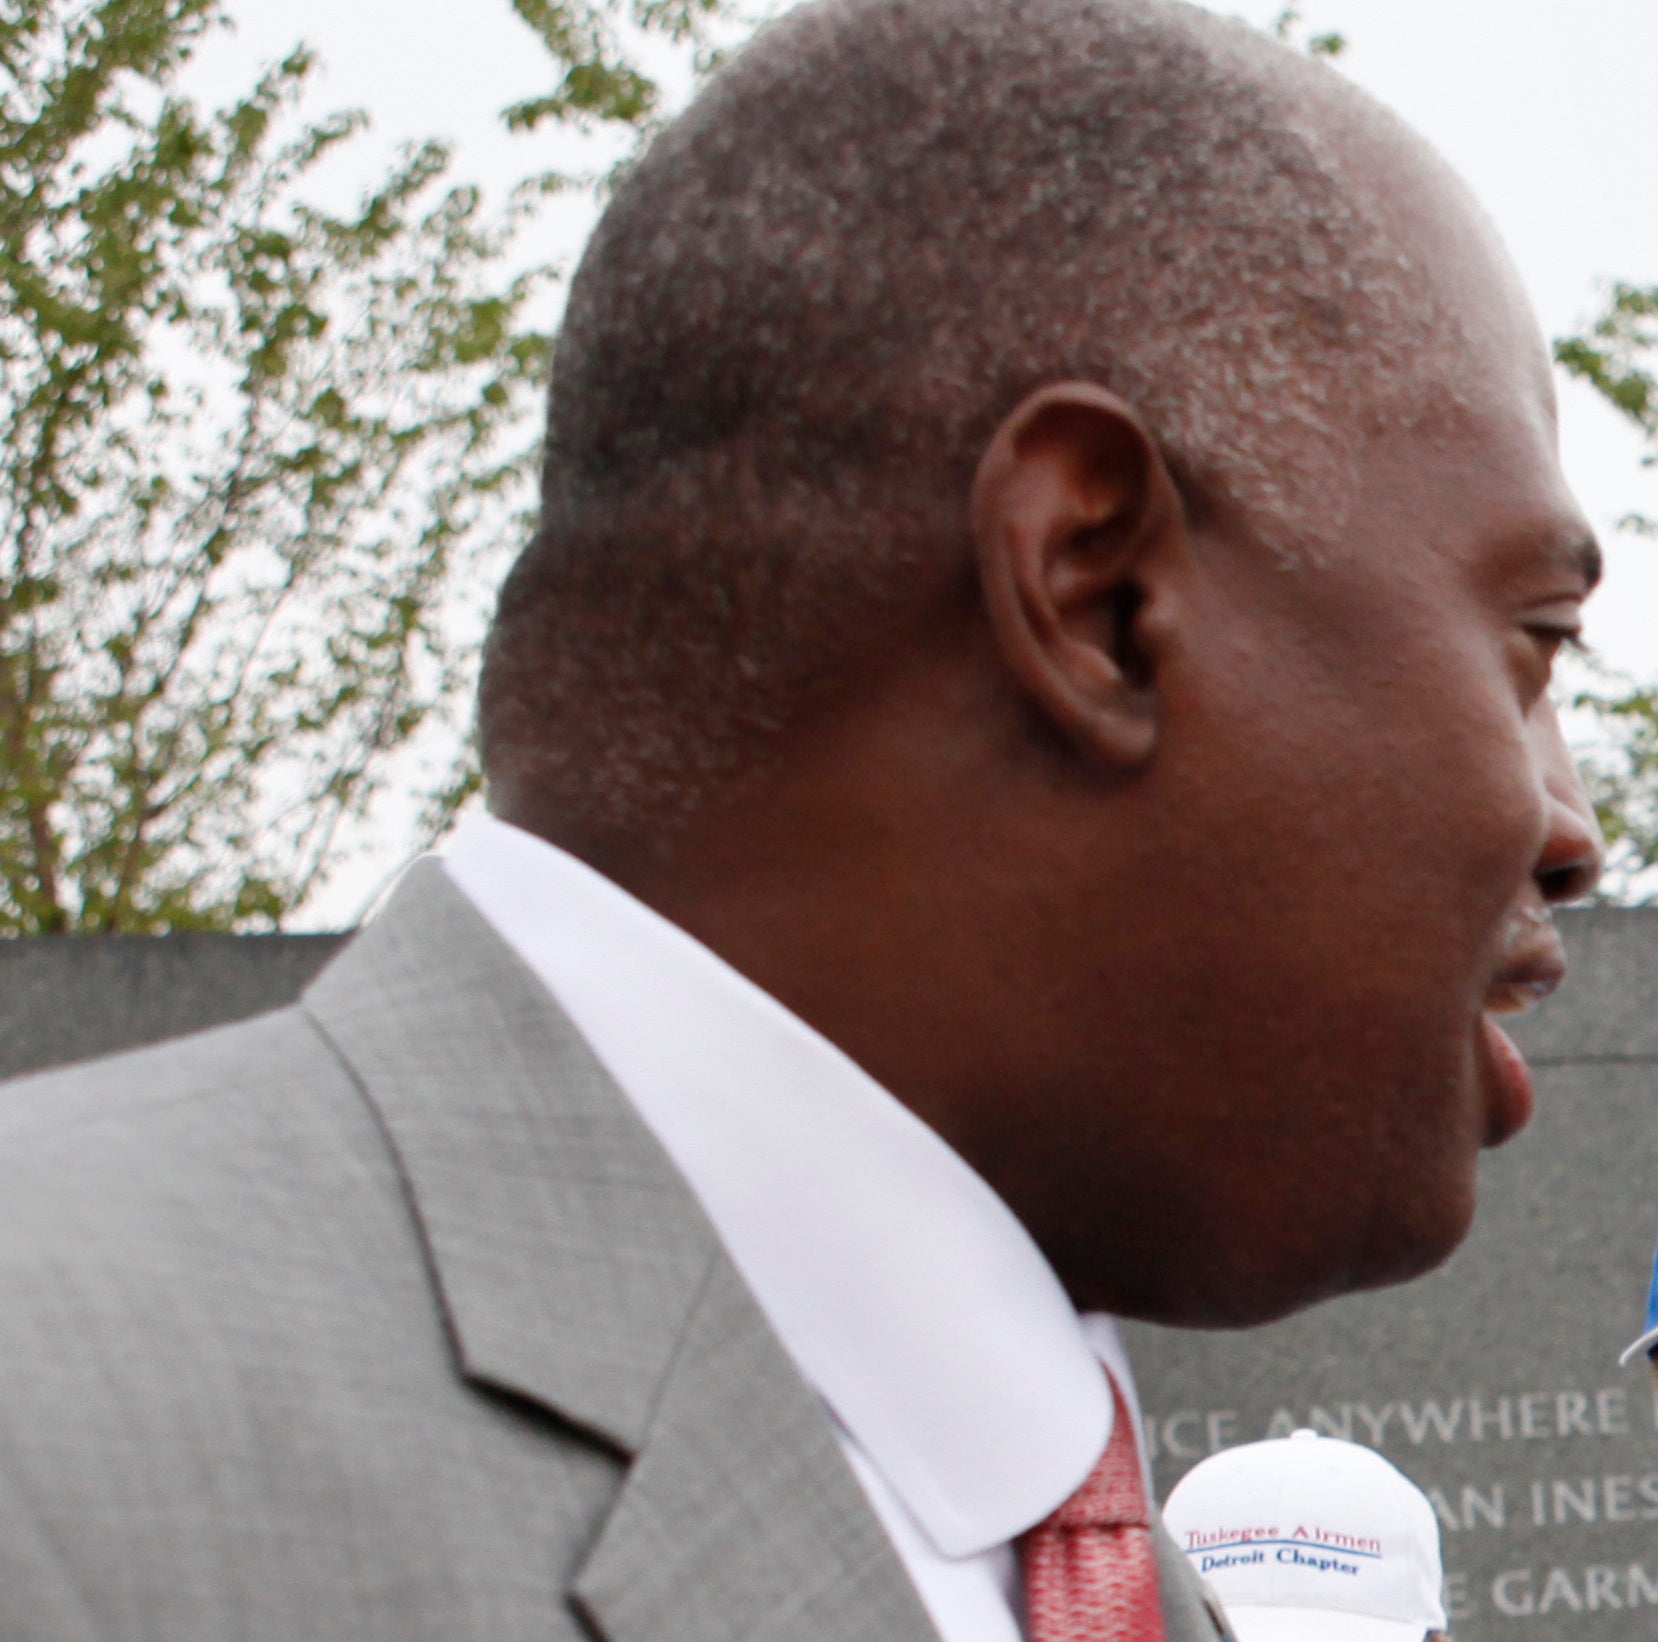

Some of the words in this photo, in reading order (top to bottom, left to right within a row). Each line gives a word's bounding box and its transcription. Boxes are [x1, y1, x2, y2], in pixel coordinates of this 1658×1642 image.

[1185, 1526, 1280, 1550] Tuskegee
[1292, 1525, 1382, 1554] Airmen
[1201, 1549, 1265, 1574] Detroit
[1275, 1548, 1361, 1577] Chapter
